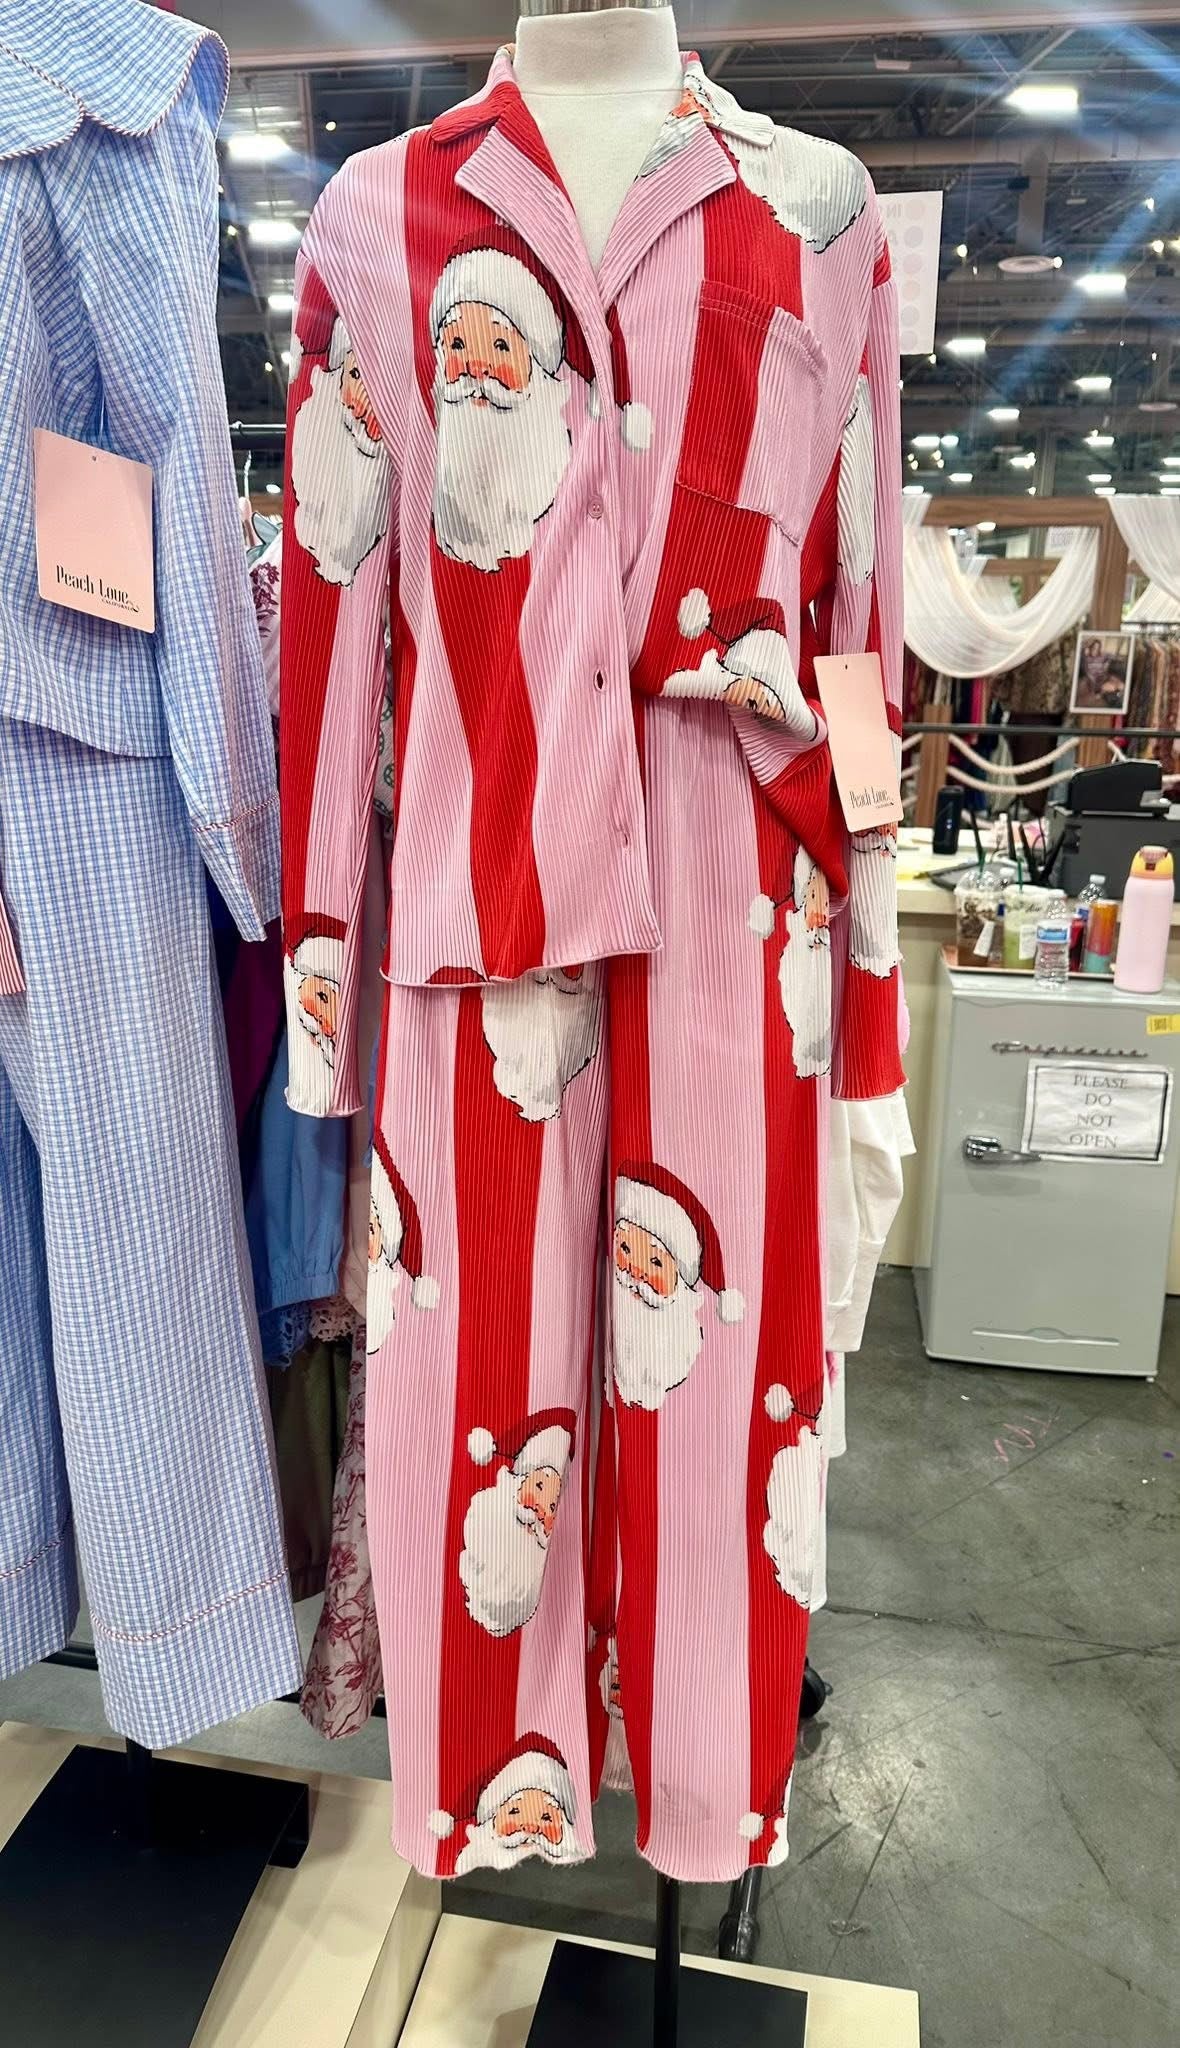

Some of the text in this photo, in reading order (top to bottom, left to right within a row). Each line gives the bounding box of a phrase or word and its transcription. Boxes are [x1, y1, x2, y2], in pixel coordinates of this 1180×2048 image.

[56, 565, 94, 594] Peach
[849, 788, 871, 808] Peach
[1074, 1074, 1128, 1089] PLEASE
[1085, 1092, 1112, 1106] DO
[1076, 1113, 1116, 1127] NOT
[1070, 1133, 1117, 1148] OPEN
